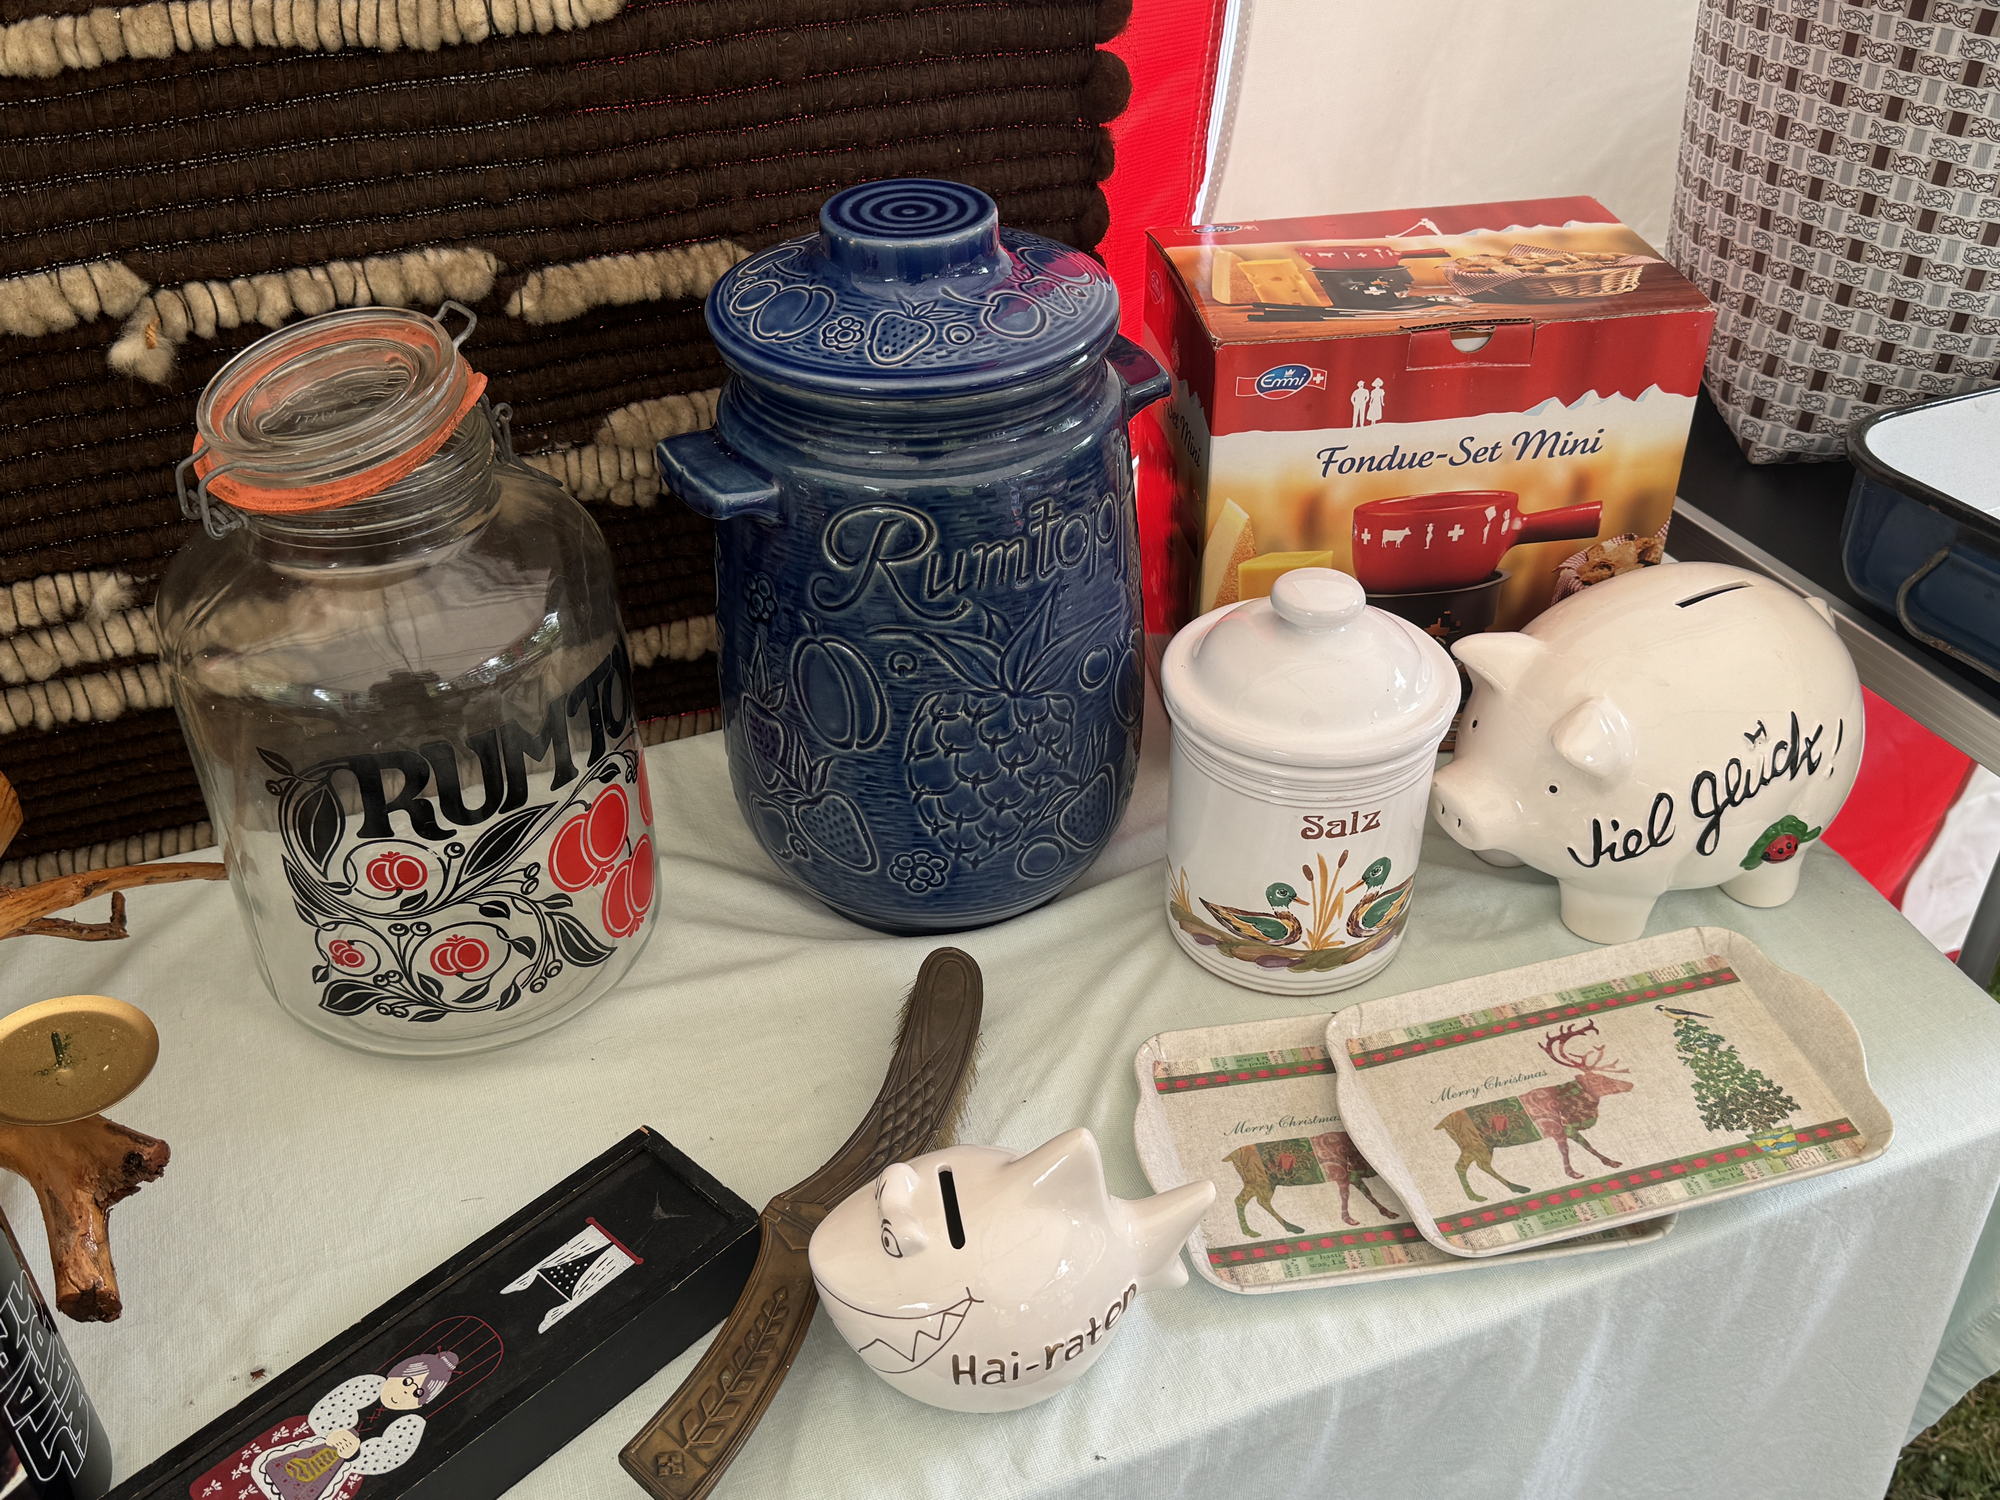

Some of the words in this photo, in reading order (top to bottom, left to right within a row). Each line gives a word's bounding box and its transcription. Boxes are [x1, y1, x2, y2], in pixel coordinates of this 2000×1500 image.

[1260, 373, 1307, 388] Emmi
[1316, 436, 1502, 478] Fondue-Set
[1511, 428, 1605, 461] Mini
[340, 638, 634, 840] RUMTO
[1300, 810, 1382, 840] Salz
[1430, 1086, 1480, 1104] Merry
[1481, 1070, 1548, 1090] Christmas
[1223, 1120, 1274, 1136] Merry
[8, 1269, 89, 1459] WARS
